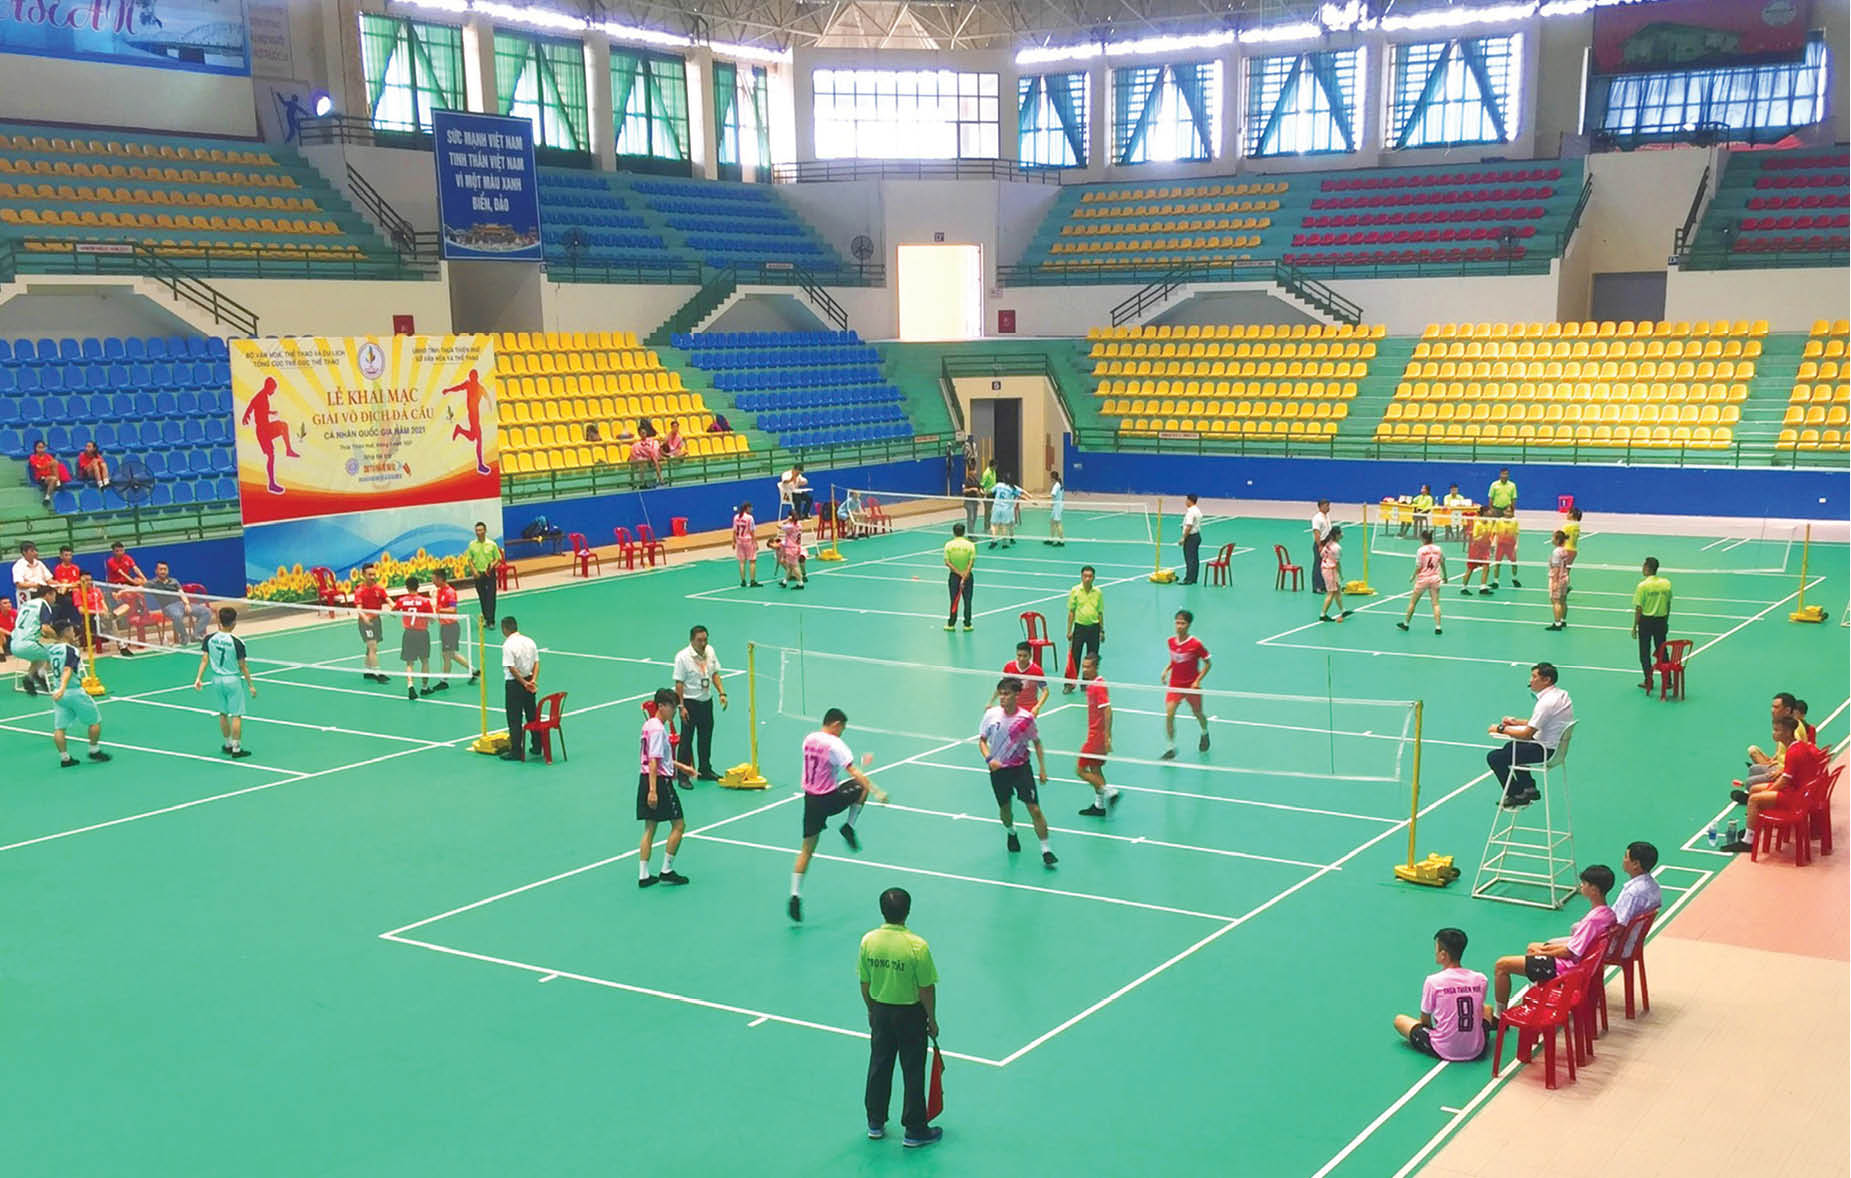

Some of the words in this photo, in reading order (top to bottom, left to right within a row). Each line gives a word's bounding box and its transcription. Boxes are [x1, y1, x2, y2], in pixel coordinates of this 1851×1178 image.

[447, 128, 462, 144] SỨC
[464, 131, 487, 149] MẠNH
[488, 132, 504, 151] VIỆT
[506, 136, 523, 150] NAM
[449, 152, 467, 166] TINH
[468, 150, 488, 168] THẦN
[489, 154, 505, 172] VIỆT
[506, 156, 524, 170] NAM
[456, 171, 464, 188] VÌ
[464, 172, 481, 191] MỘT
[482, 173, 500, 190] MÀU
[502, 177, 521, 191] XANH
[472, 192, 493, 212] BIỂN,
[494, 194, 509, 212] ĐẢO
[327, 386, 344, 406] LỄ
[347, 389, 383, 405] KHAI
[388, 388, 418, 406] MẠC
[361, 410, 390, 423] ĐỊCH
[393, 407, 409, 420] ĐÁ
[411, 405, 434, 419] CẦU
[324, 431, 335, 440] CÁ
[336, 430, 356, 439] NHÂN
[358, 427, 378, 437] QUỐC
[380, 428, 392, 436] GIA
[394, 424, 409, 435] NĂM
[736, 525, 746, 537] 17
[1427, 557, 1434, 570] 4
[18, 609, 30, 629] 2
[408, 608, 416, 626] 7
[365, 630, 373, 638] 10
[216, 646, 225, 666] 7
[52, 658, 60, 678] 8
[805, 754, 818, 784] 17
[1457, 996, 1473, 1032] 8
